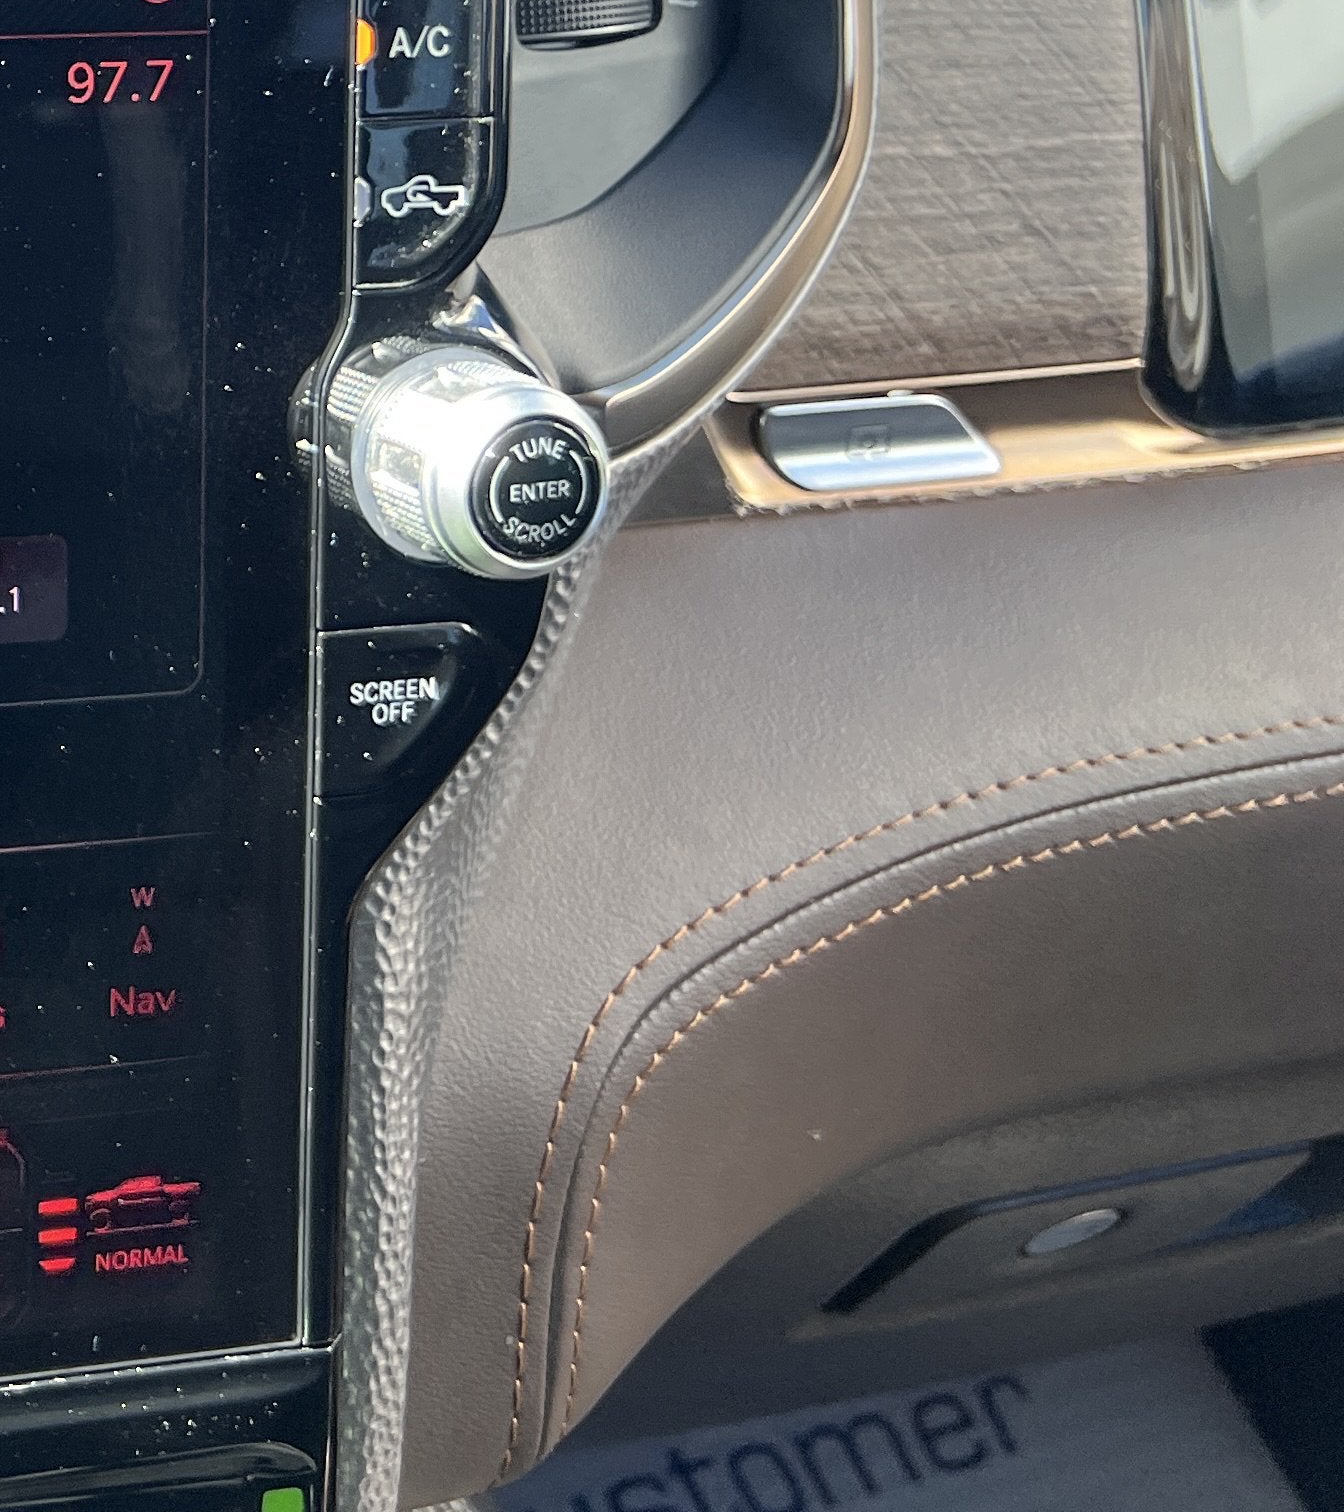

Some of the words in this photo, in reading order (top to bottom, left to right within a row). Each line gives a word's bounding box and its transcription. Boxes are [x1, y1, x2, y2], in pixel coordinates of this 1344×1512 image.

[388, 25, 451, 58] A/C
[67, 59, 174, 104] 97.7
[508, 436, 567, 464] TUNE
[509, 479, 571, 504] ENTER
[502, 513, 577, 543] SCROLL
[349, 676, 440, 707] SCREEN
[371, 700, 416, 727] OFF
[130, 886, 155, 908] W
[109, 985, 177, 1019] Nav
[94, 1243, 189, 1274] NORMAL
